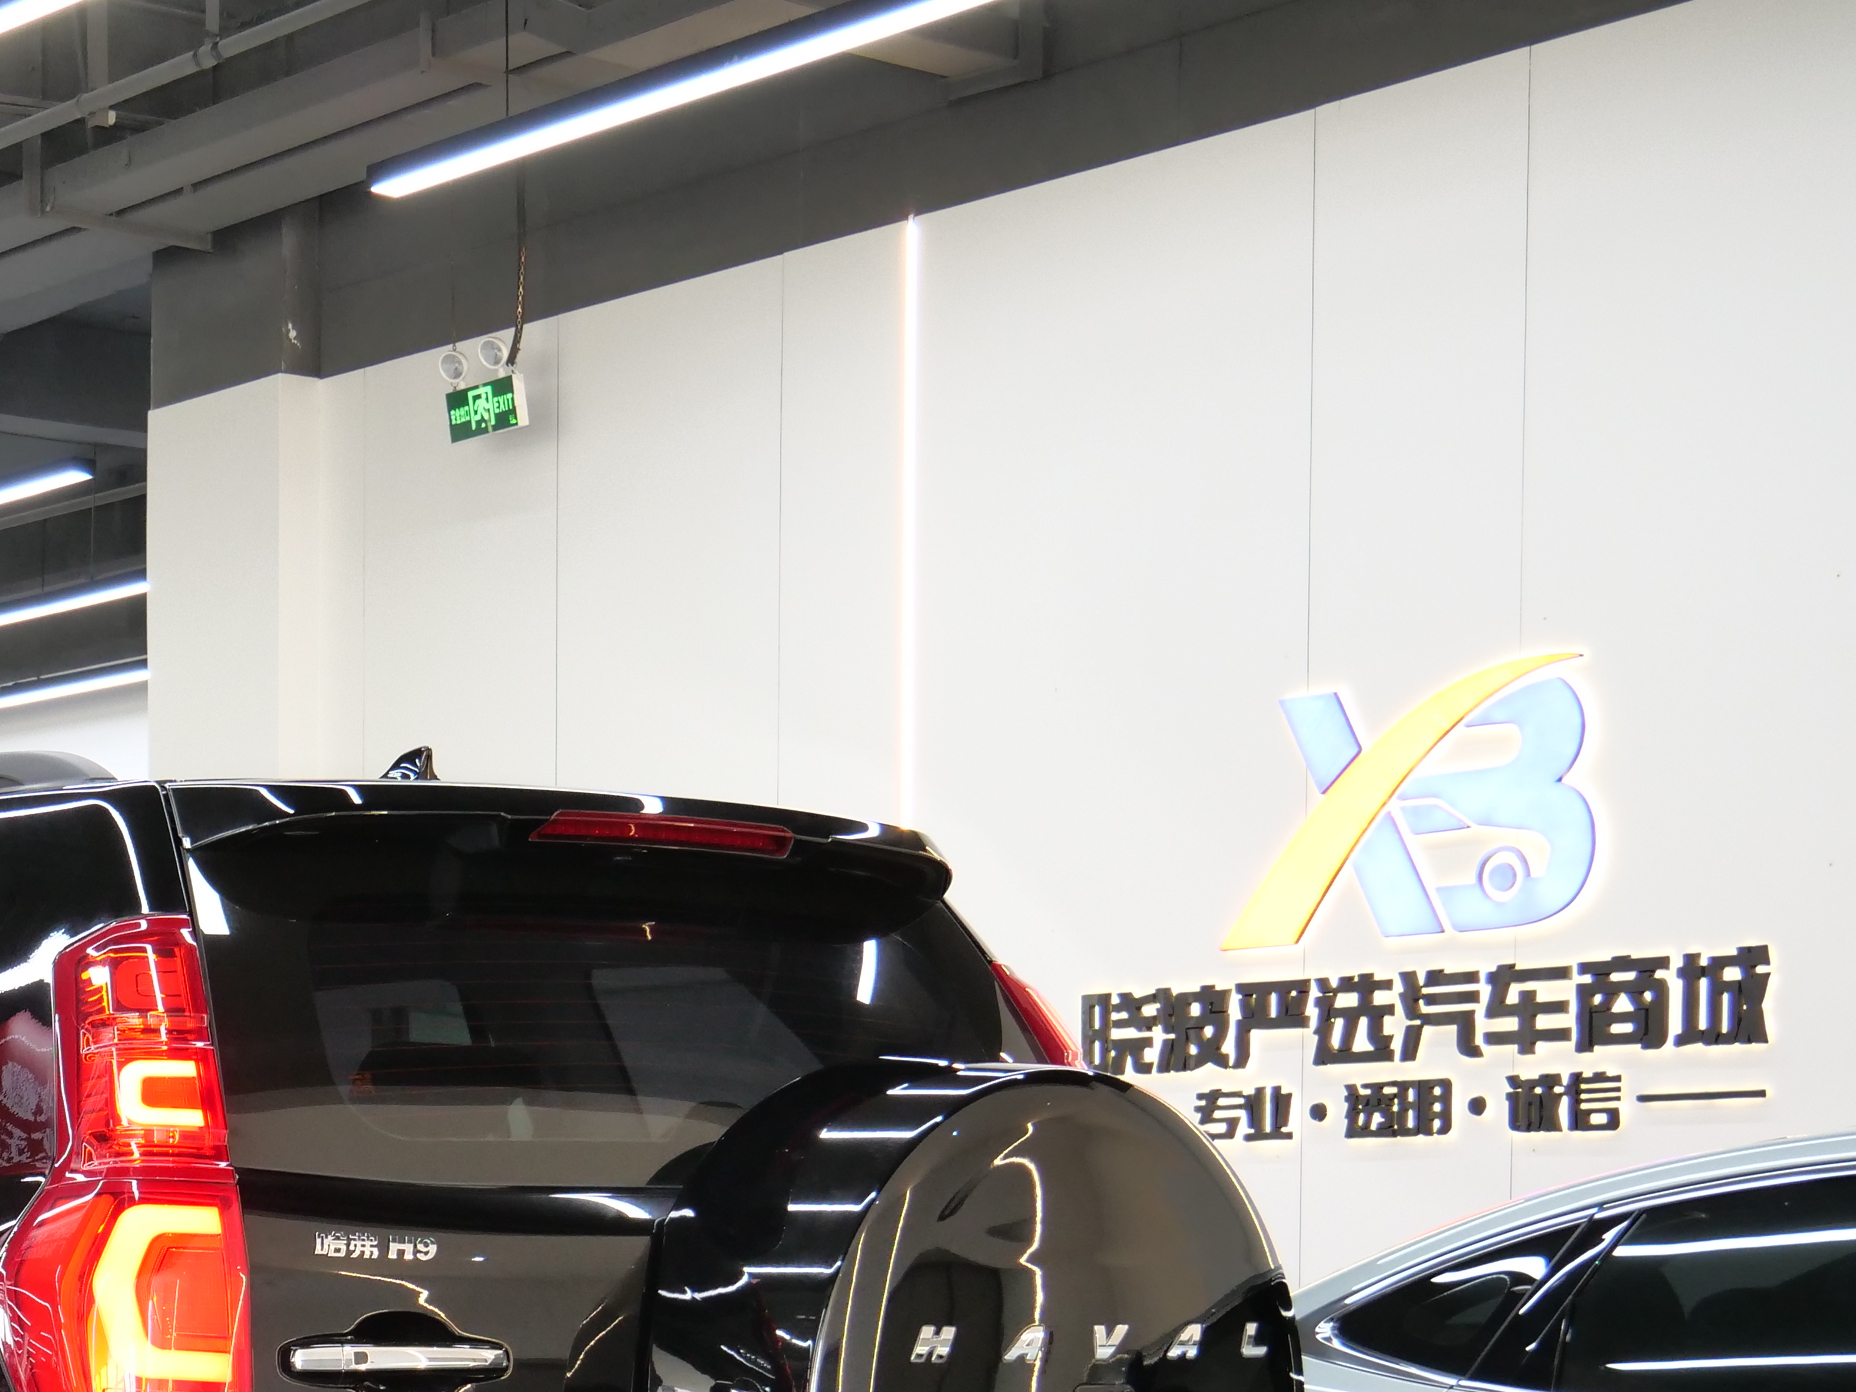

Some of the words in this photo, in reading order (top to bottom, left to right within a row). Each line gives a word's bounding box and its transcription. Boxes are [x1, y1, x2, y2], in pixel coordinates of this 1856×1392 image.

[493, 393, 513, 413] EXIT
[1081, 944, 1771, 1075] 晓波严选汽车商城
[314, 1230, 380, 1259] 哈弗
[387, 1234, 438, 1261] H9
[910, 1321, 1268, 1364] HAVAL
